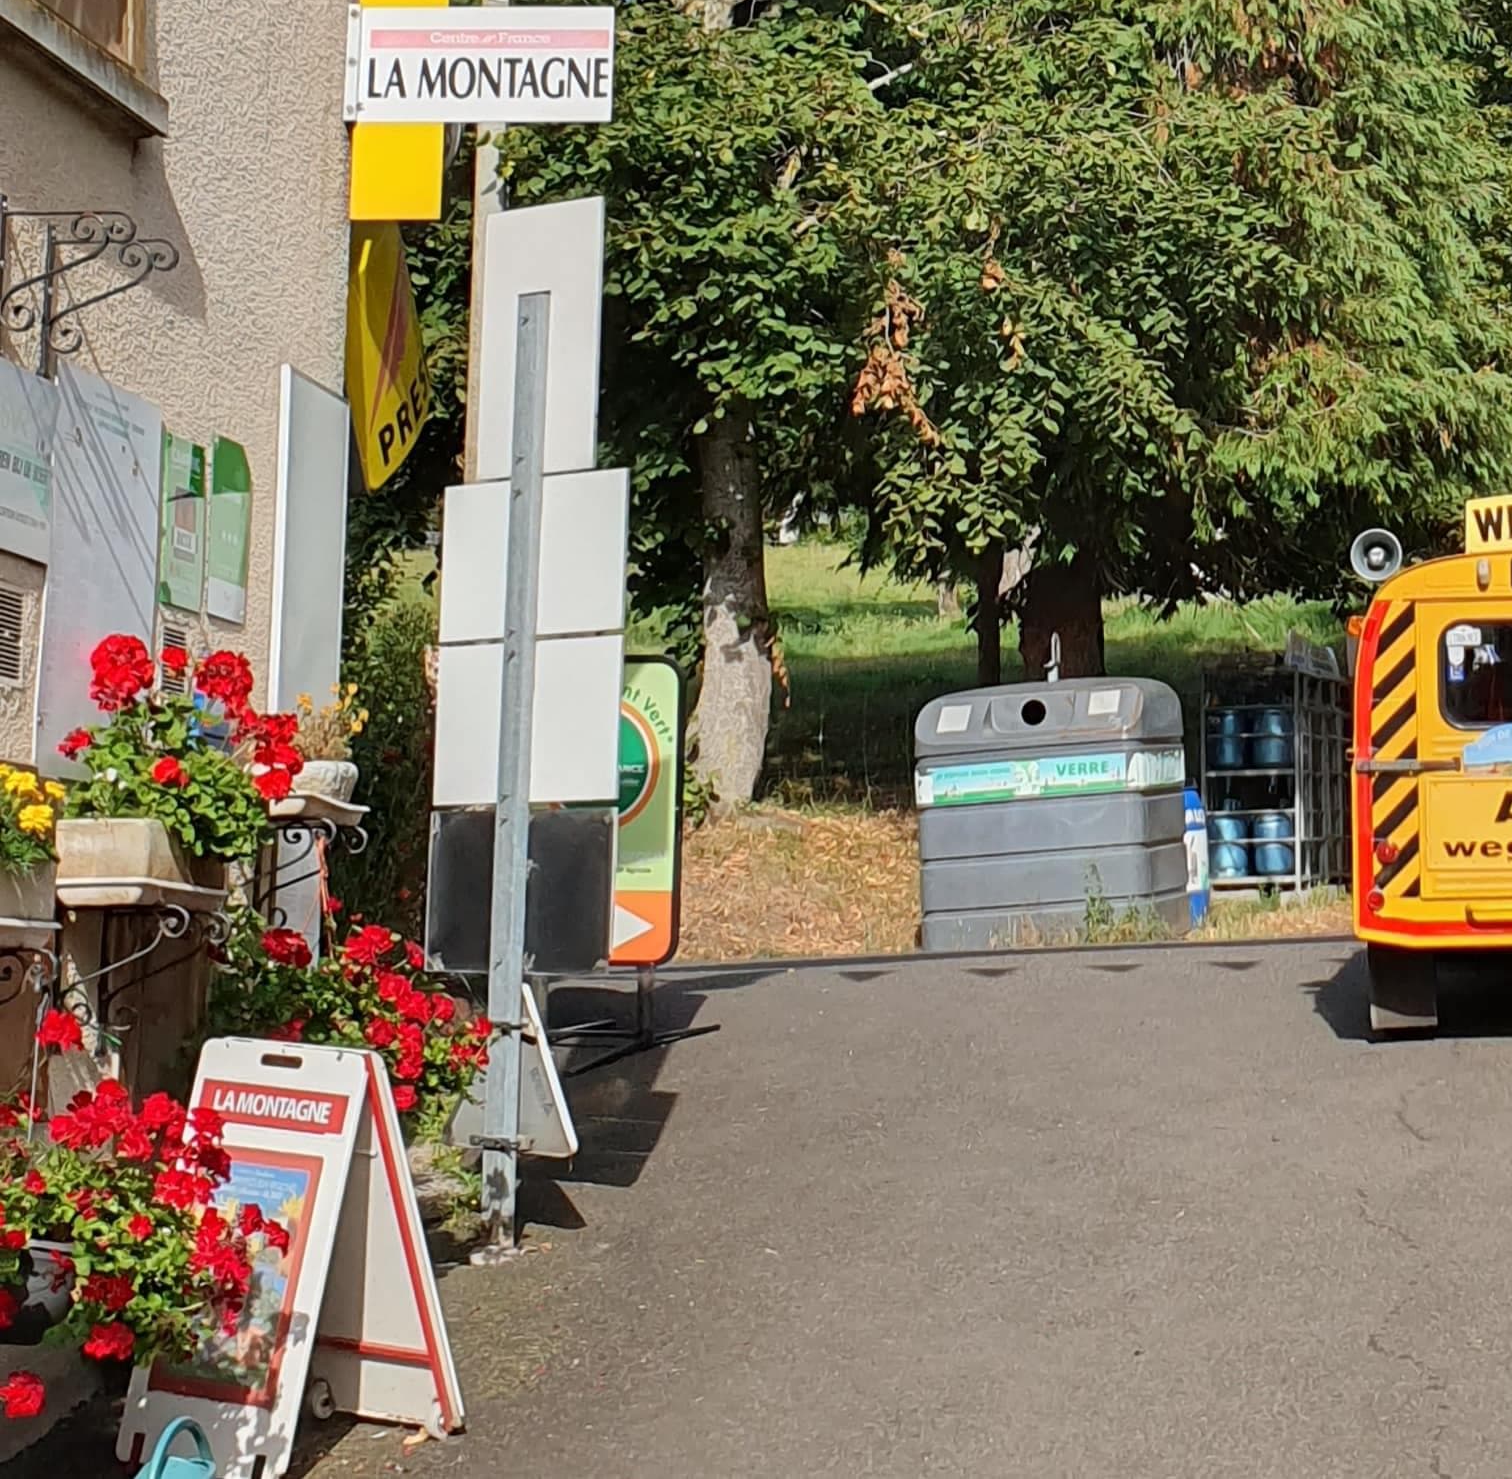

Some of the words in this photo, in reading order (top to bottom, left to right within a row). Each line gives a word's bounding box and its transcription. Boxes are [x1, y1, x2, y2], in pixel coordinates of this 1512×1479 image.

[368, 57, 407, 99] LA
[416, 57, 609, 99] MONTAGNE
[1056, 761, 1109, 777] VERRE
[212, 1089, 235, 1112] LA
[236, 1092, 332, 1124] MONTAGNE
